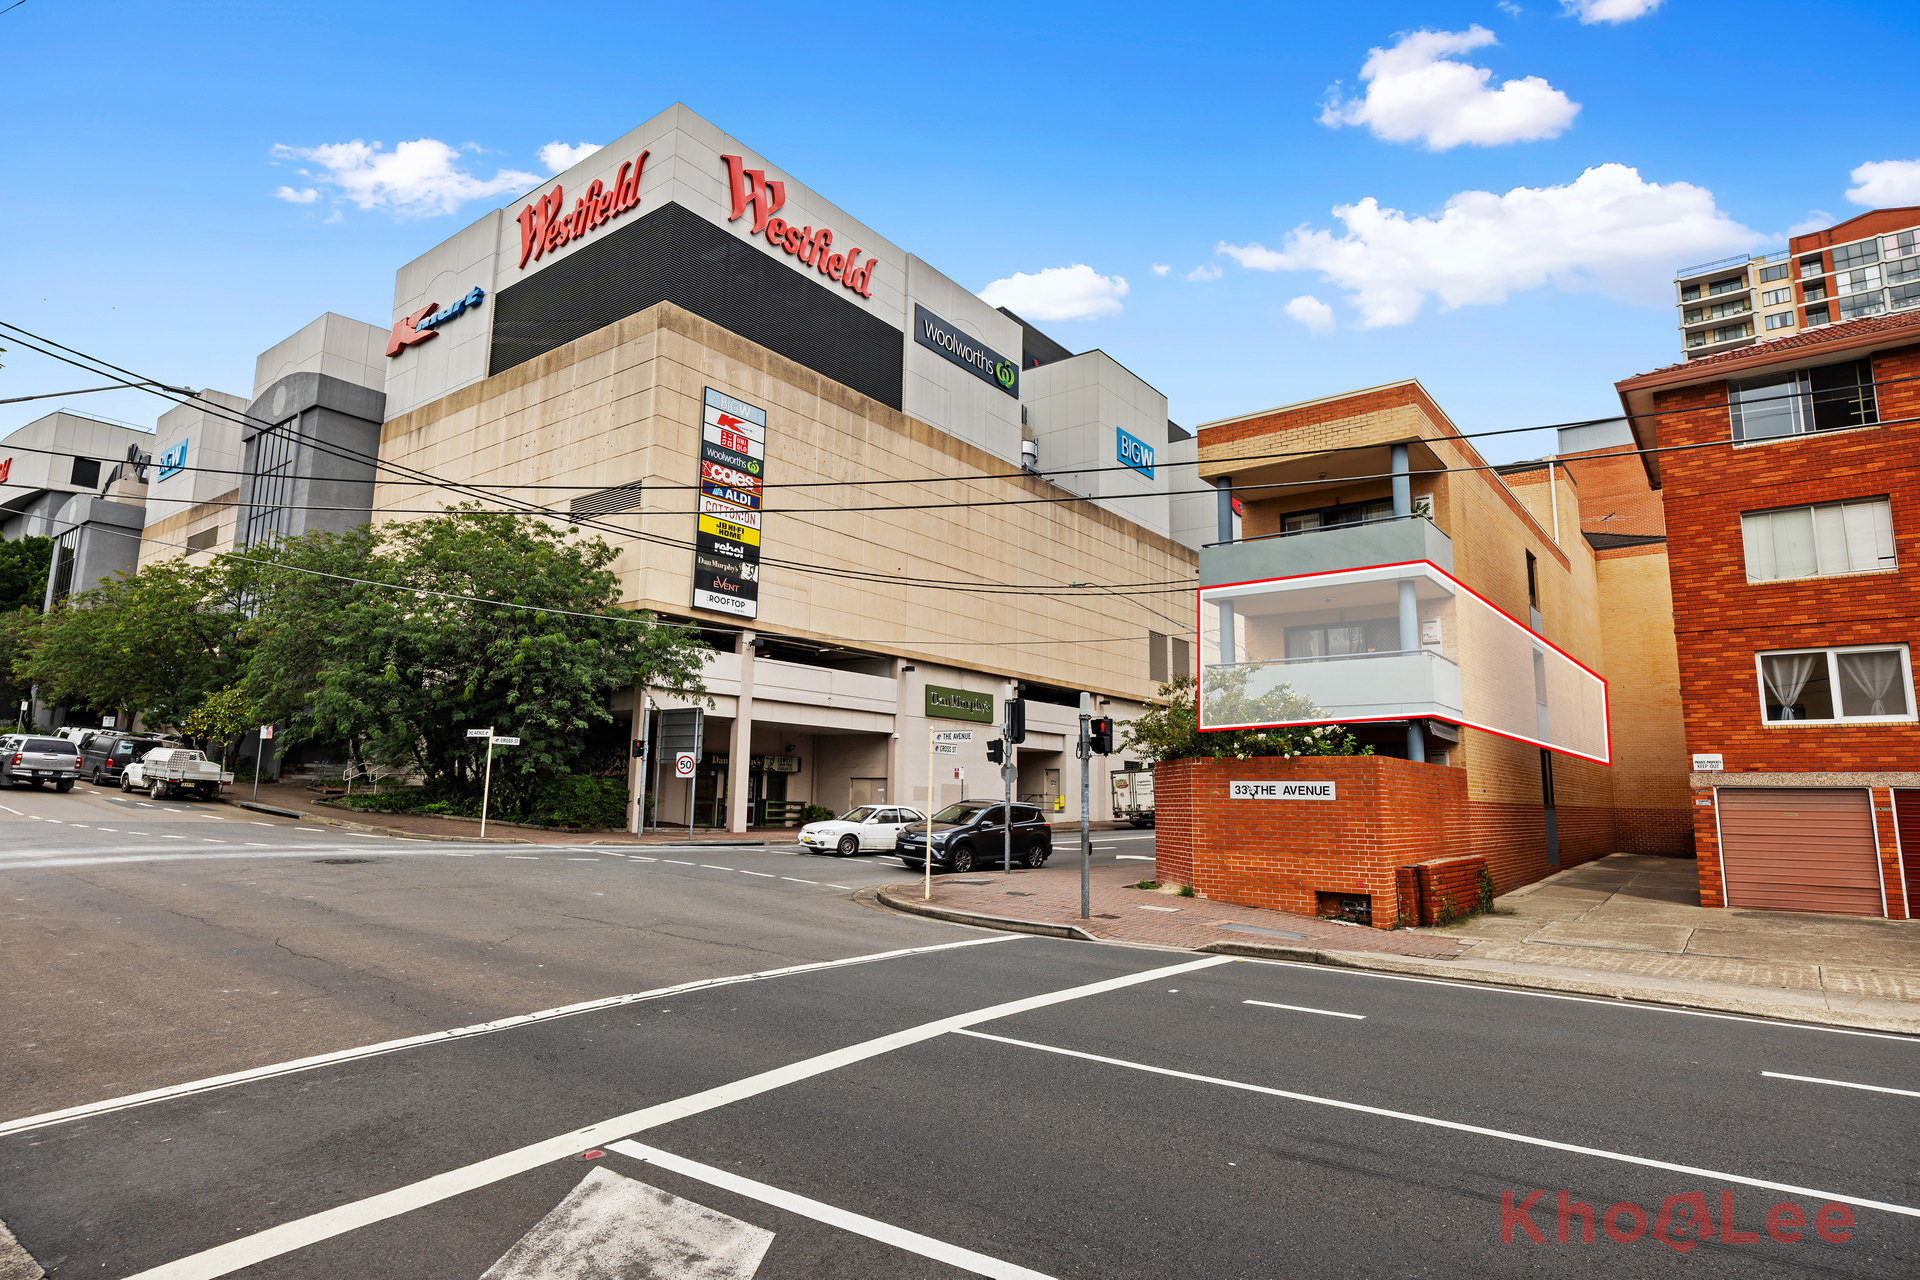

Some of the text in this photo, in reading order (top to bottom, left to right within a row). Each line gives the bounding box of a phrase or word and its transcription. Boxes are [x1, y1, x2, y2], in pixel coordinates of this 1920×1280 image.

[516, 149, 650, 270] Westfield
[720, 154, 878, 298] Westfield
[386, 286, 484, 358] Kmart
[923, 319, 994, 375] Woolworths
[706, 447, 747, 469] Woolworths
[711, 464, 755, 491] coles
[725, 489, 752, 506] ALDI
[716, 521, 728, 530] JB
[714, 541, 744, 559] rebel
[709, 594, 746, 609] ROOFTOP
[943, 732, 972, 741] THE AVENUE
[940, 745, 957, 754] CROSS ST
[680, 760, 692, 770] 50
[712, 755, 728, 765] Dan
[1234, 784, 1331, 796] 33 THE AVENUE
